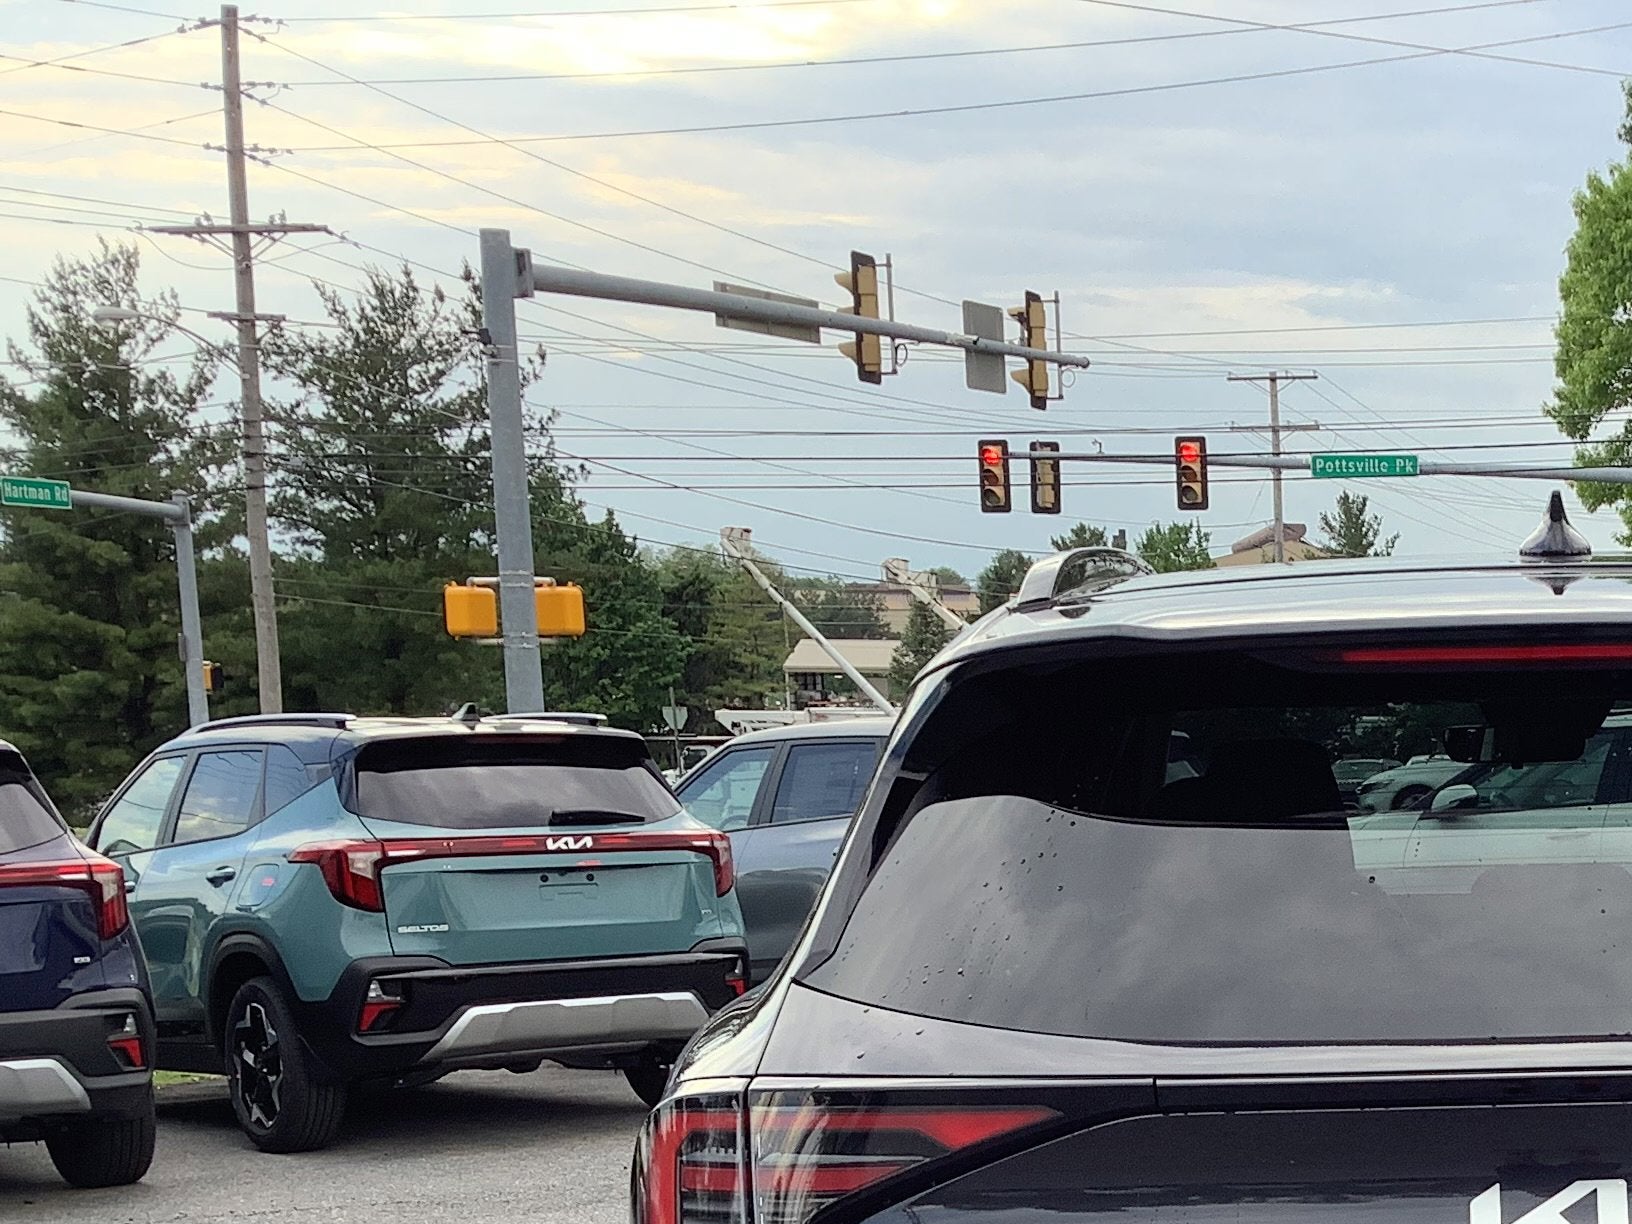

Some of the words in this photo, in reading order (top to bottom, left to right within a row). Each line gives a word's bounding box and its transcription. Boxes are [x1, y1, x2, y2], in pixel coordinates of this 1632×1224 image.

[1315, 458, 1388, 473] Pottsville
[1396, 458, 1414, 473] Pk
[4, 481, 51, 500] Hartman
[54, 485, 68, 502] Rd
[546, 835, 593, 850] KIA
